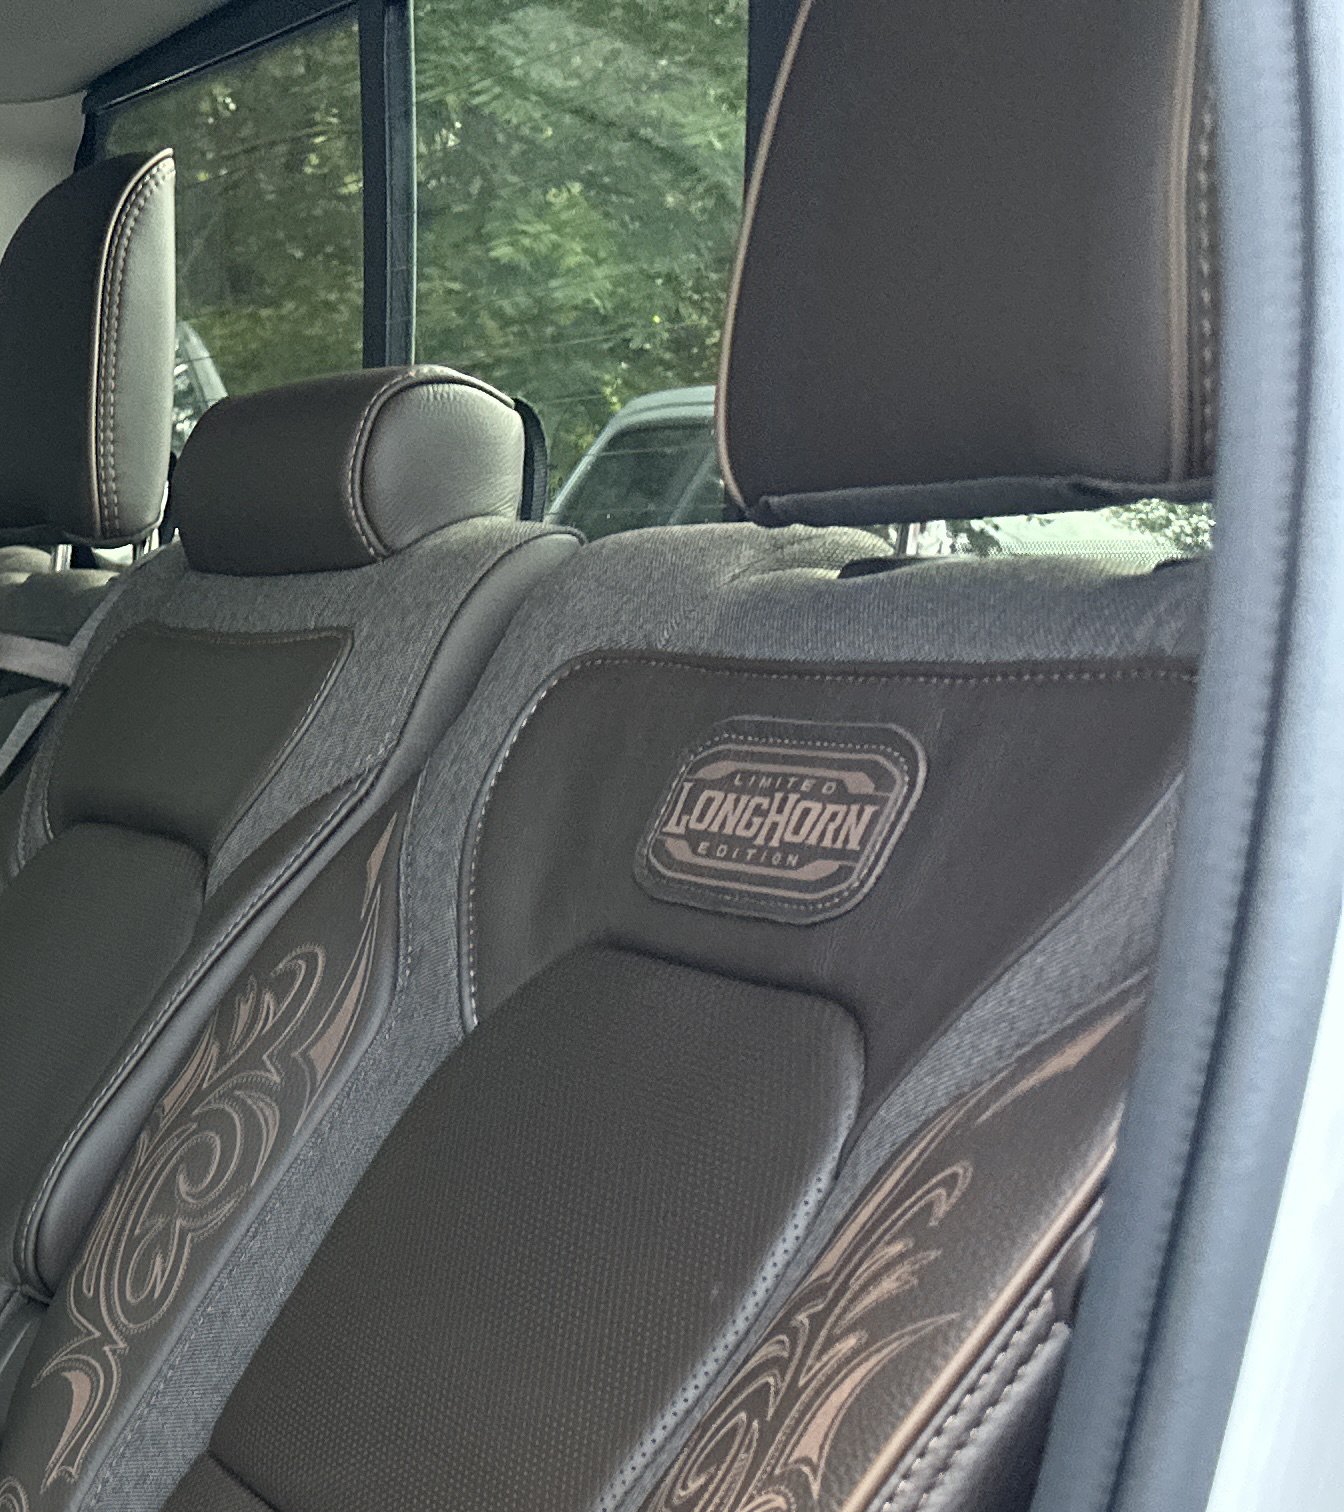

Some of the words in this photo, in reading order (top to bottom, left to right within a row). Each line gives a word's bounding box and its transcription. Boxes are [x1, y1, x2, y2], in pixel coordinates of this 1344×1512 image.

[733, 772, 839, 795] LIMITED
[662, 781, 880, 850] LONGHORN
[696, 841, 800, 867] EDITION
